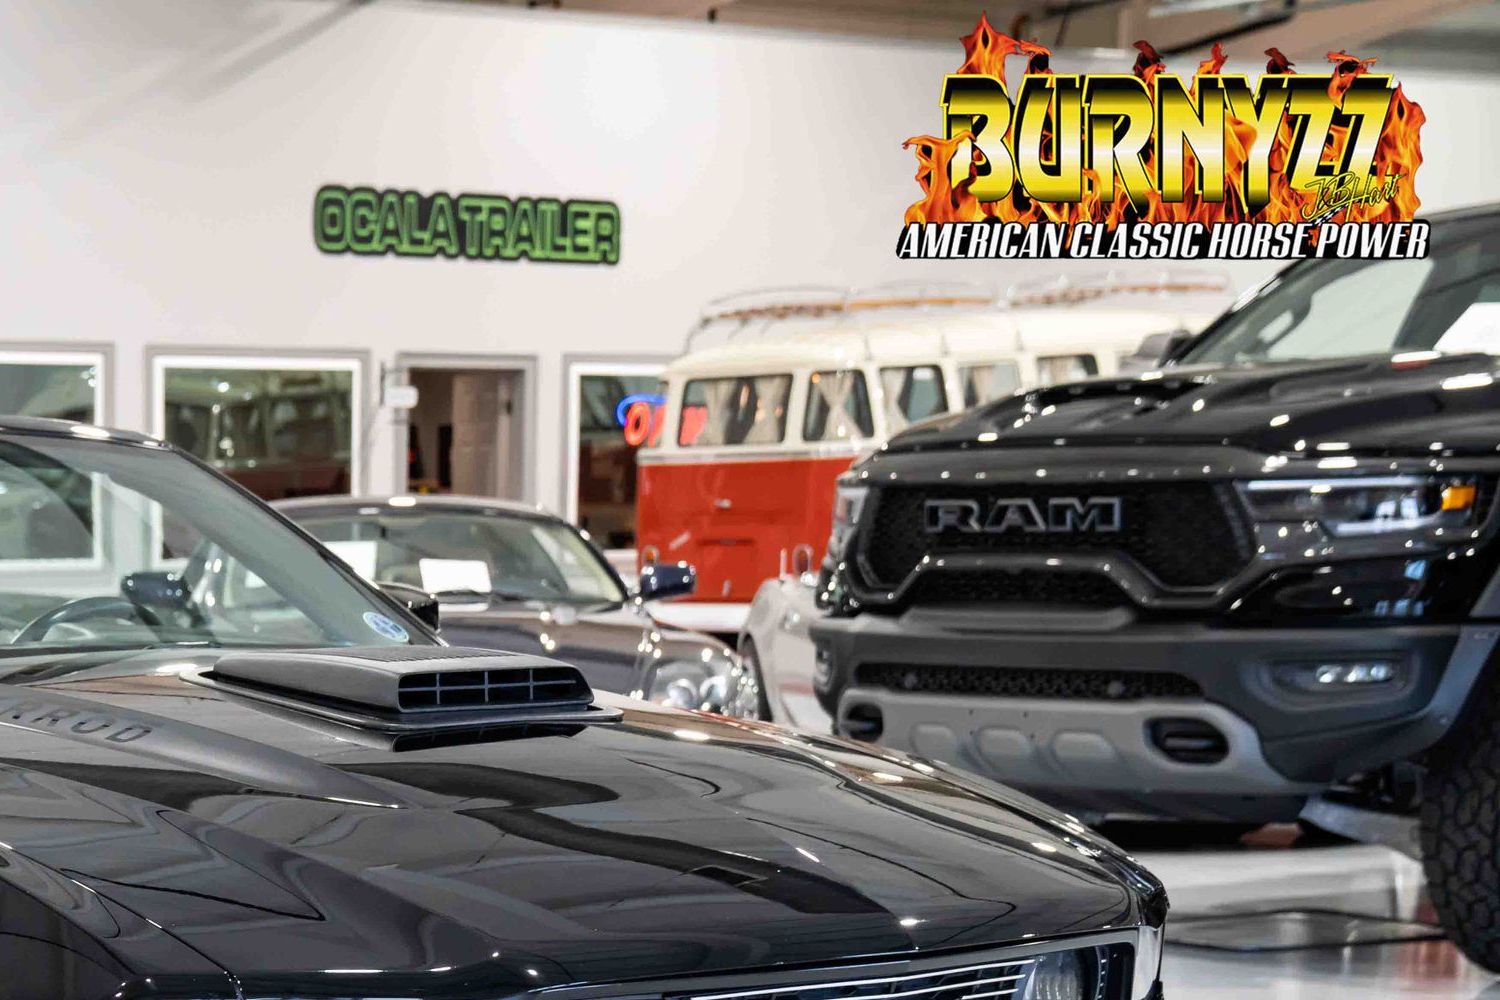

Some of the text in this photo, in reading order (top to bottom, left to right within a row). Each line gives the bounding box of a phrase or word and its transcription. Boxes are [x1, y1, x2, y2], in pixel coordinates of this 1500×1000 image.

[315, 186, 620, 264] OCALA TRAILER
[924, 498, 1122, 533] RAM
